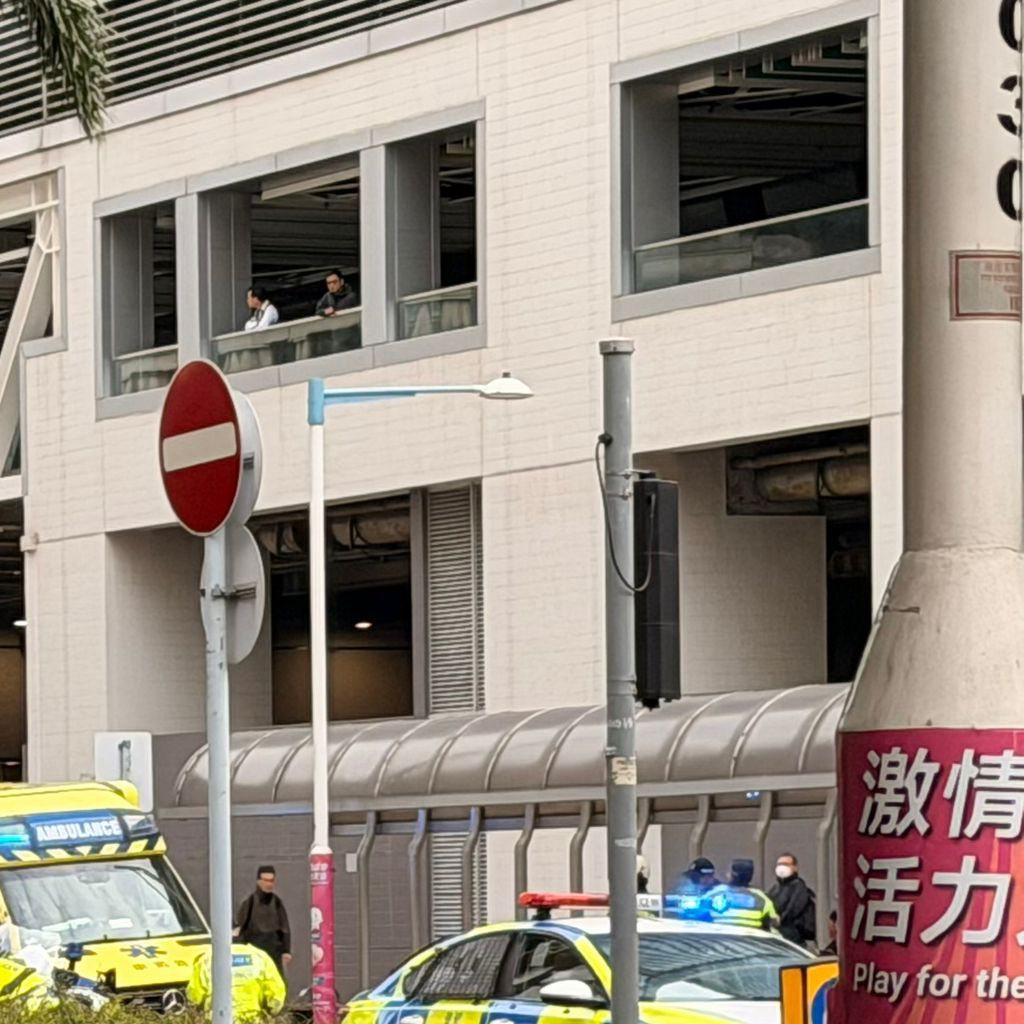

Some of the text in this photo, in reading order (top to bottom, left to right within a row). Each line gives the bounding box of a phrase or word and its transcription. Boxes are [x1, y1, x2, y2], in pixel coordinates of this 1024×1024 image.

[858, 747, 1024, 839] 激情
[36, 820, 122, 842] AMBULANCE
[851, 854, 1024, 947] 活力
[852, 962, 908, 1003] Play
[915, 964, 968, 998] for
